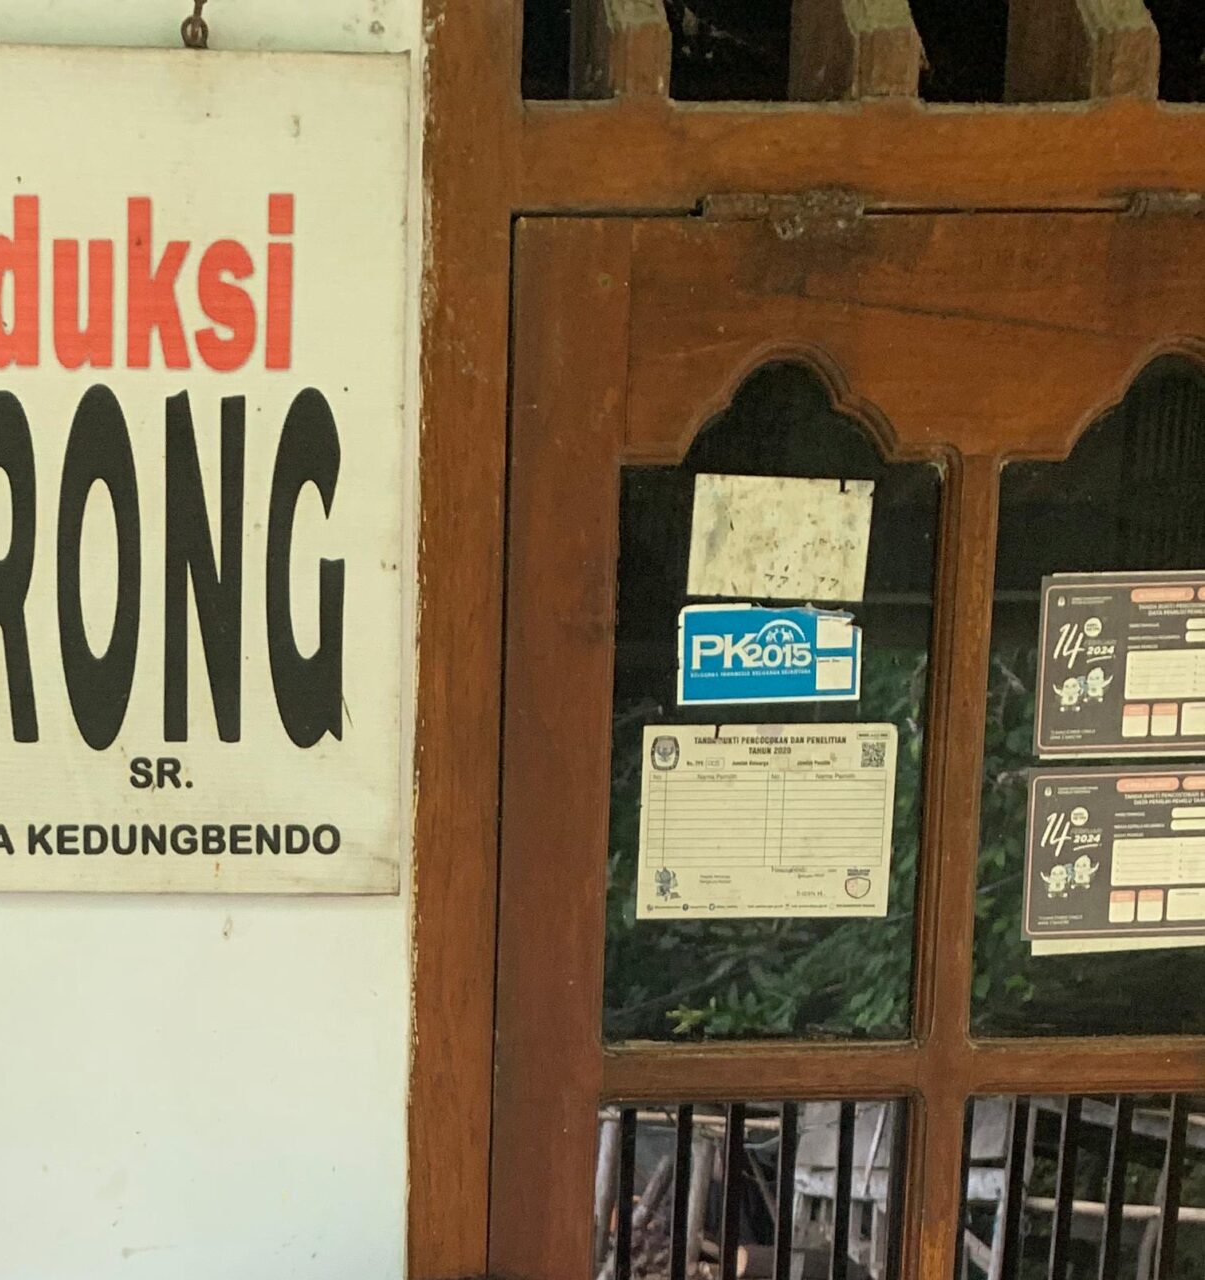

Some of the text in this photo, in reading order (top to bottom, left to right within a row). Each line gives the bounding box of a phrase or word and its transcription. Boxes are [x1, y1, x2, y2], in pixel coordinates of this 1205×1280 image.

[1053, 623, 1085, 669] 14
[129, 757, 193, 789] SR.
[28, 824, 341, 856] KEDUNGBENDO
[1040, 812, 1071, 857] 14
[1073, 834, 1101, 843] 2024
